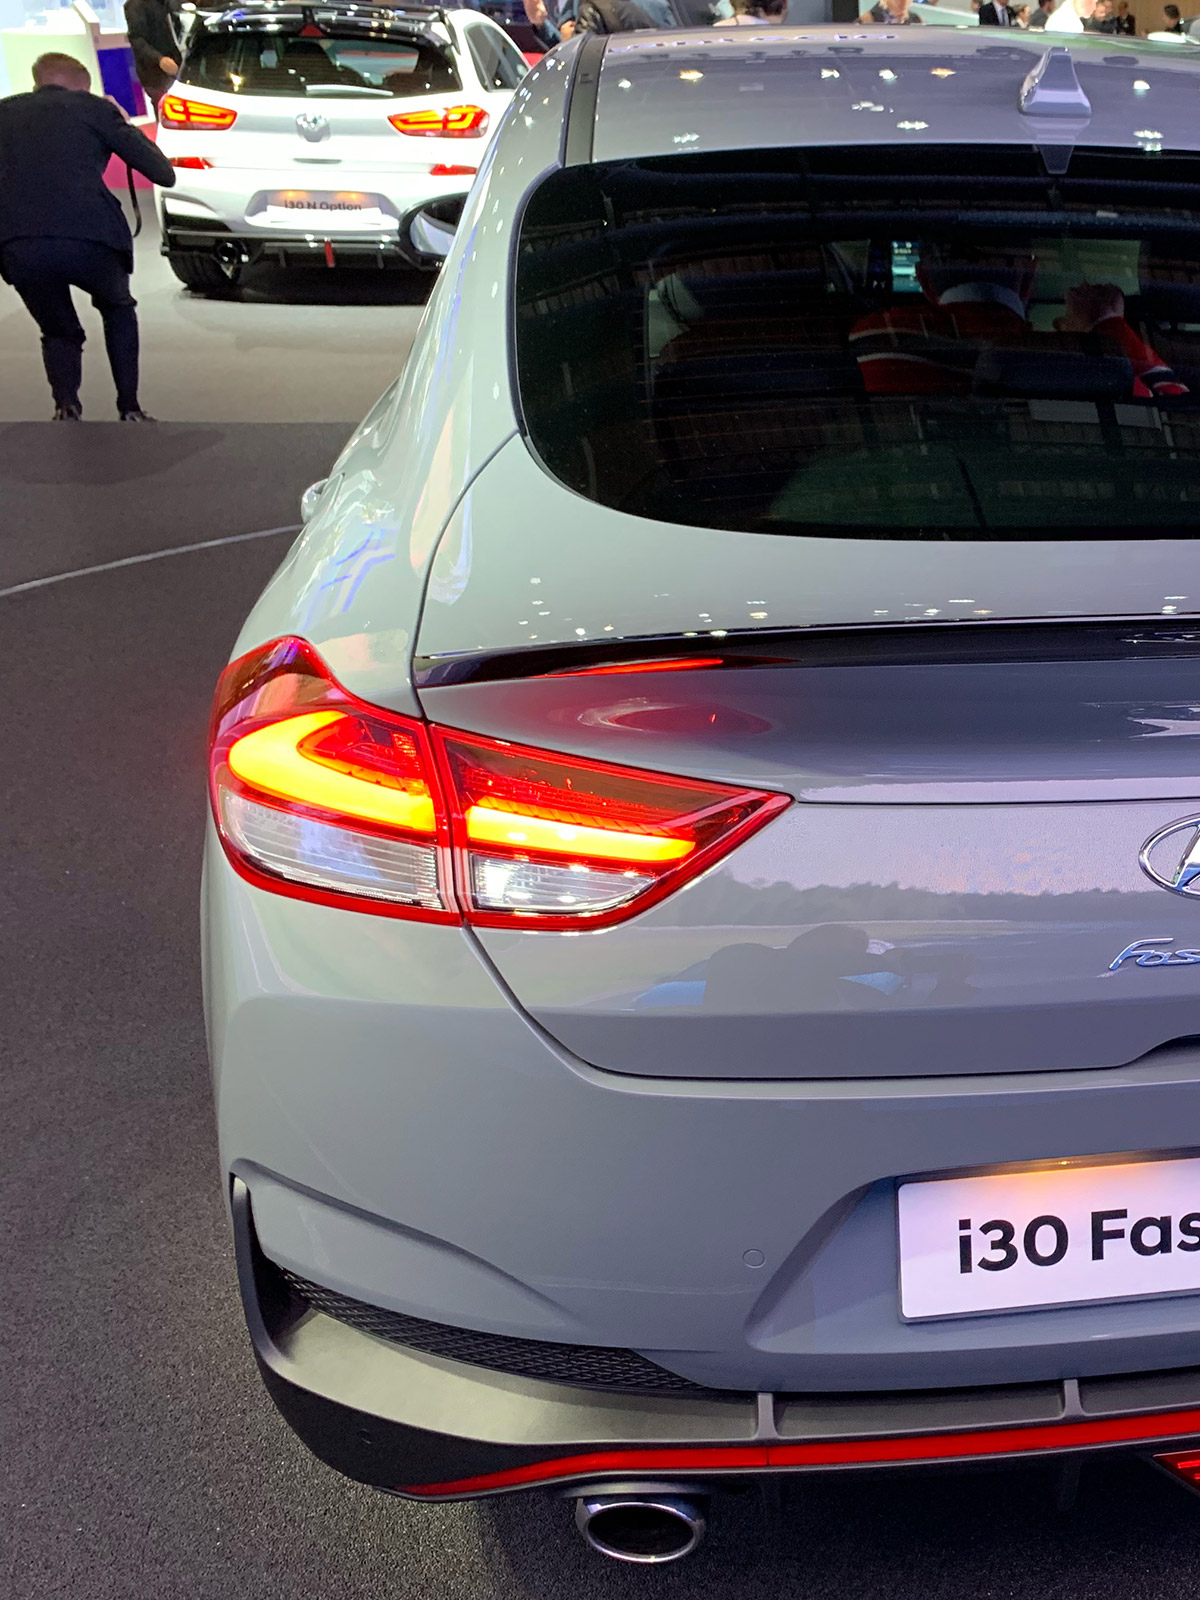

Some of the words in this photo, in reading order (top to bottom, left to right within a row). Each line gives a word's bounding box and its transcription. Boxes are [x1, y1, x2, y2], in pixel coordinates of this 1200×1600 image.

[284, 200, 304, 210] i30
[307, 201, 317, 210] N
[319, 202, 362, 212] Option
[958, 1215, 1068, 1274] i30
